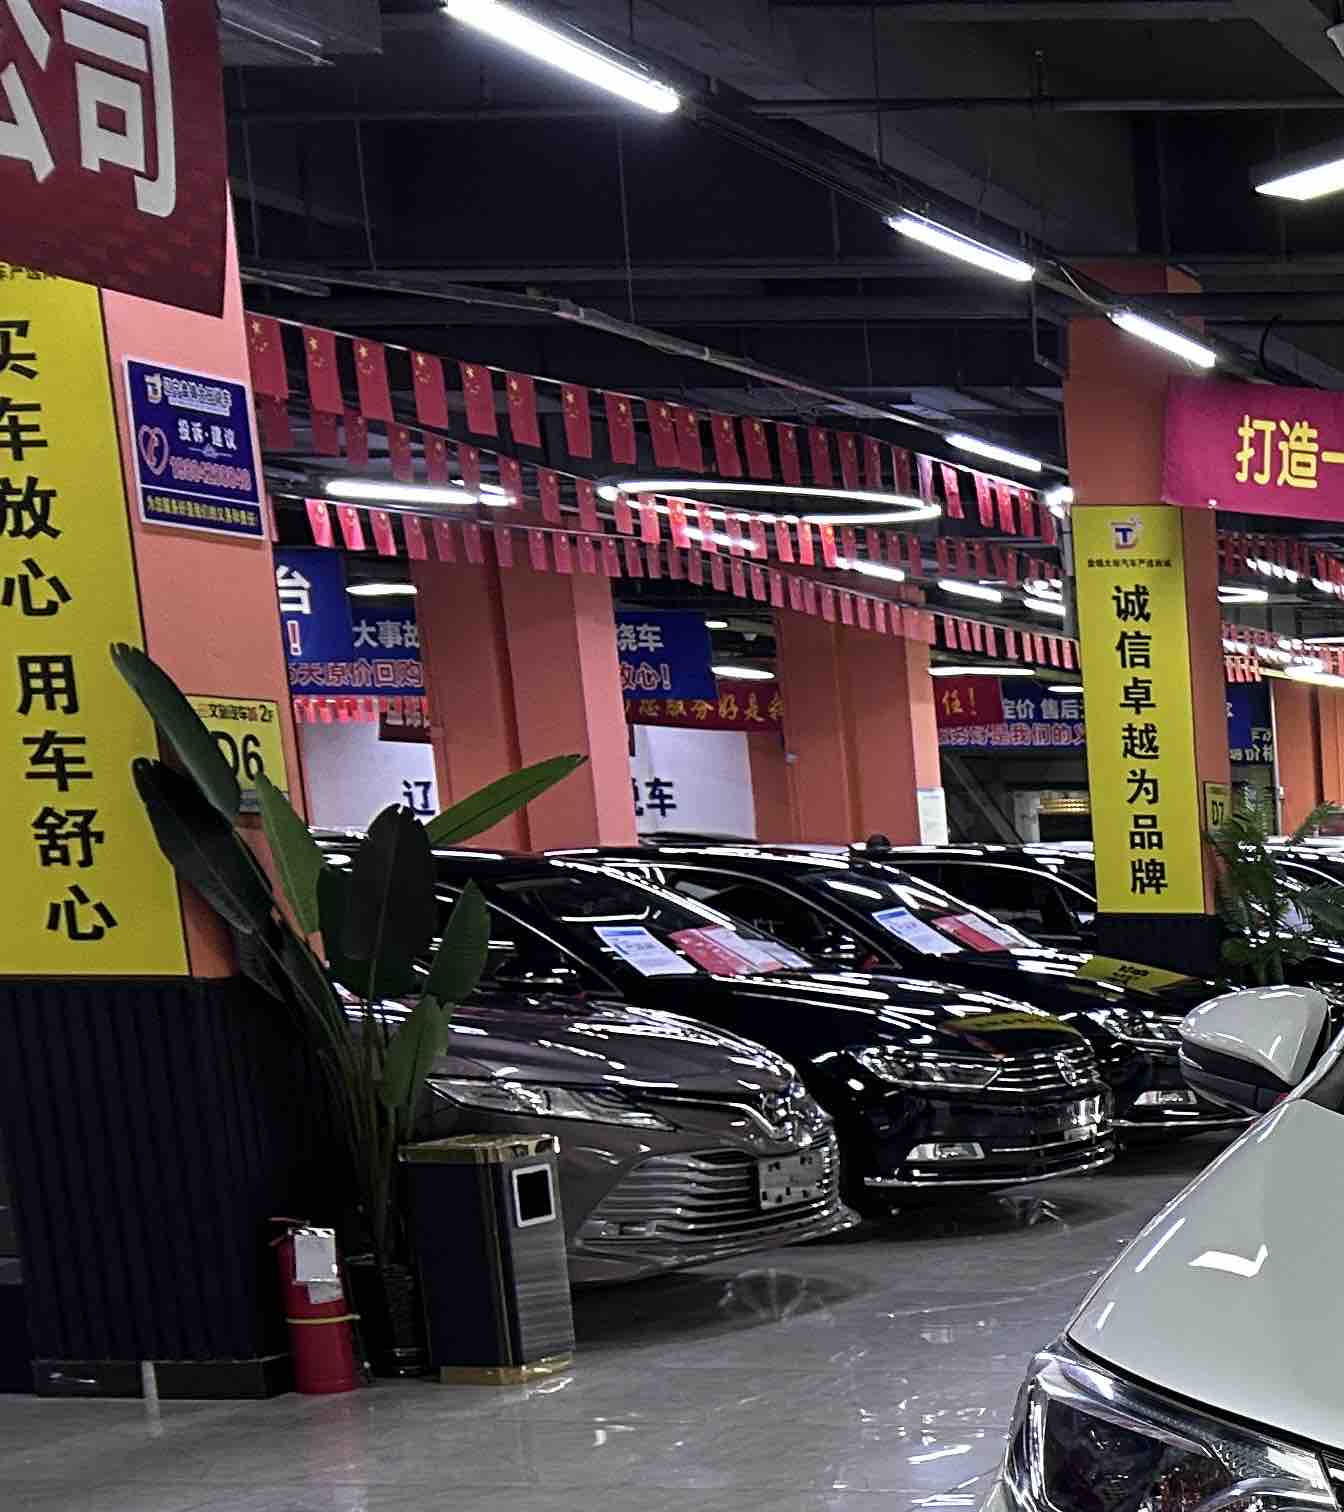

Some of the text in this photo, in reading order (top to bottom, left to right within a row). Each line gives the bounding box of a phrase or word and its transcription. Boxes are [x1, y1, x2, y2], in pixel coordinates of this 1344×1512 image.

[17, 654, 118, 942] 用车舒心
[1111, 583, 1169, 896] 诚信卓越为品牌
